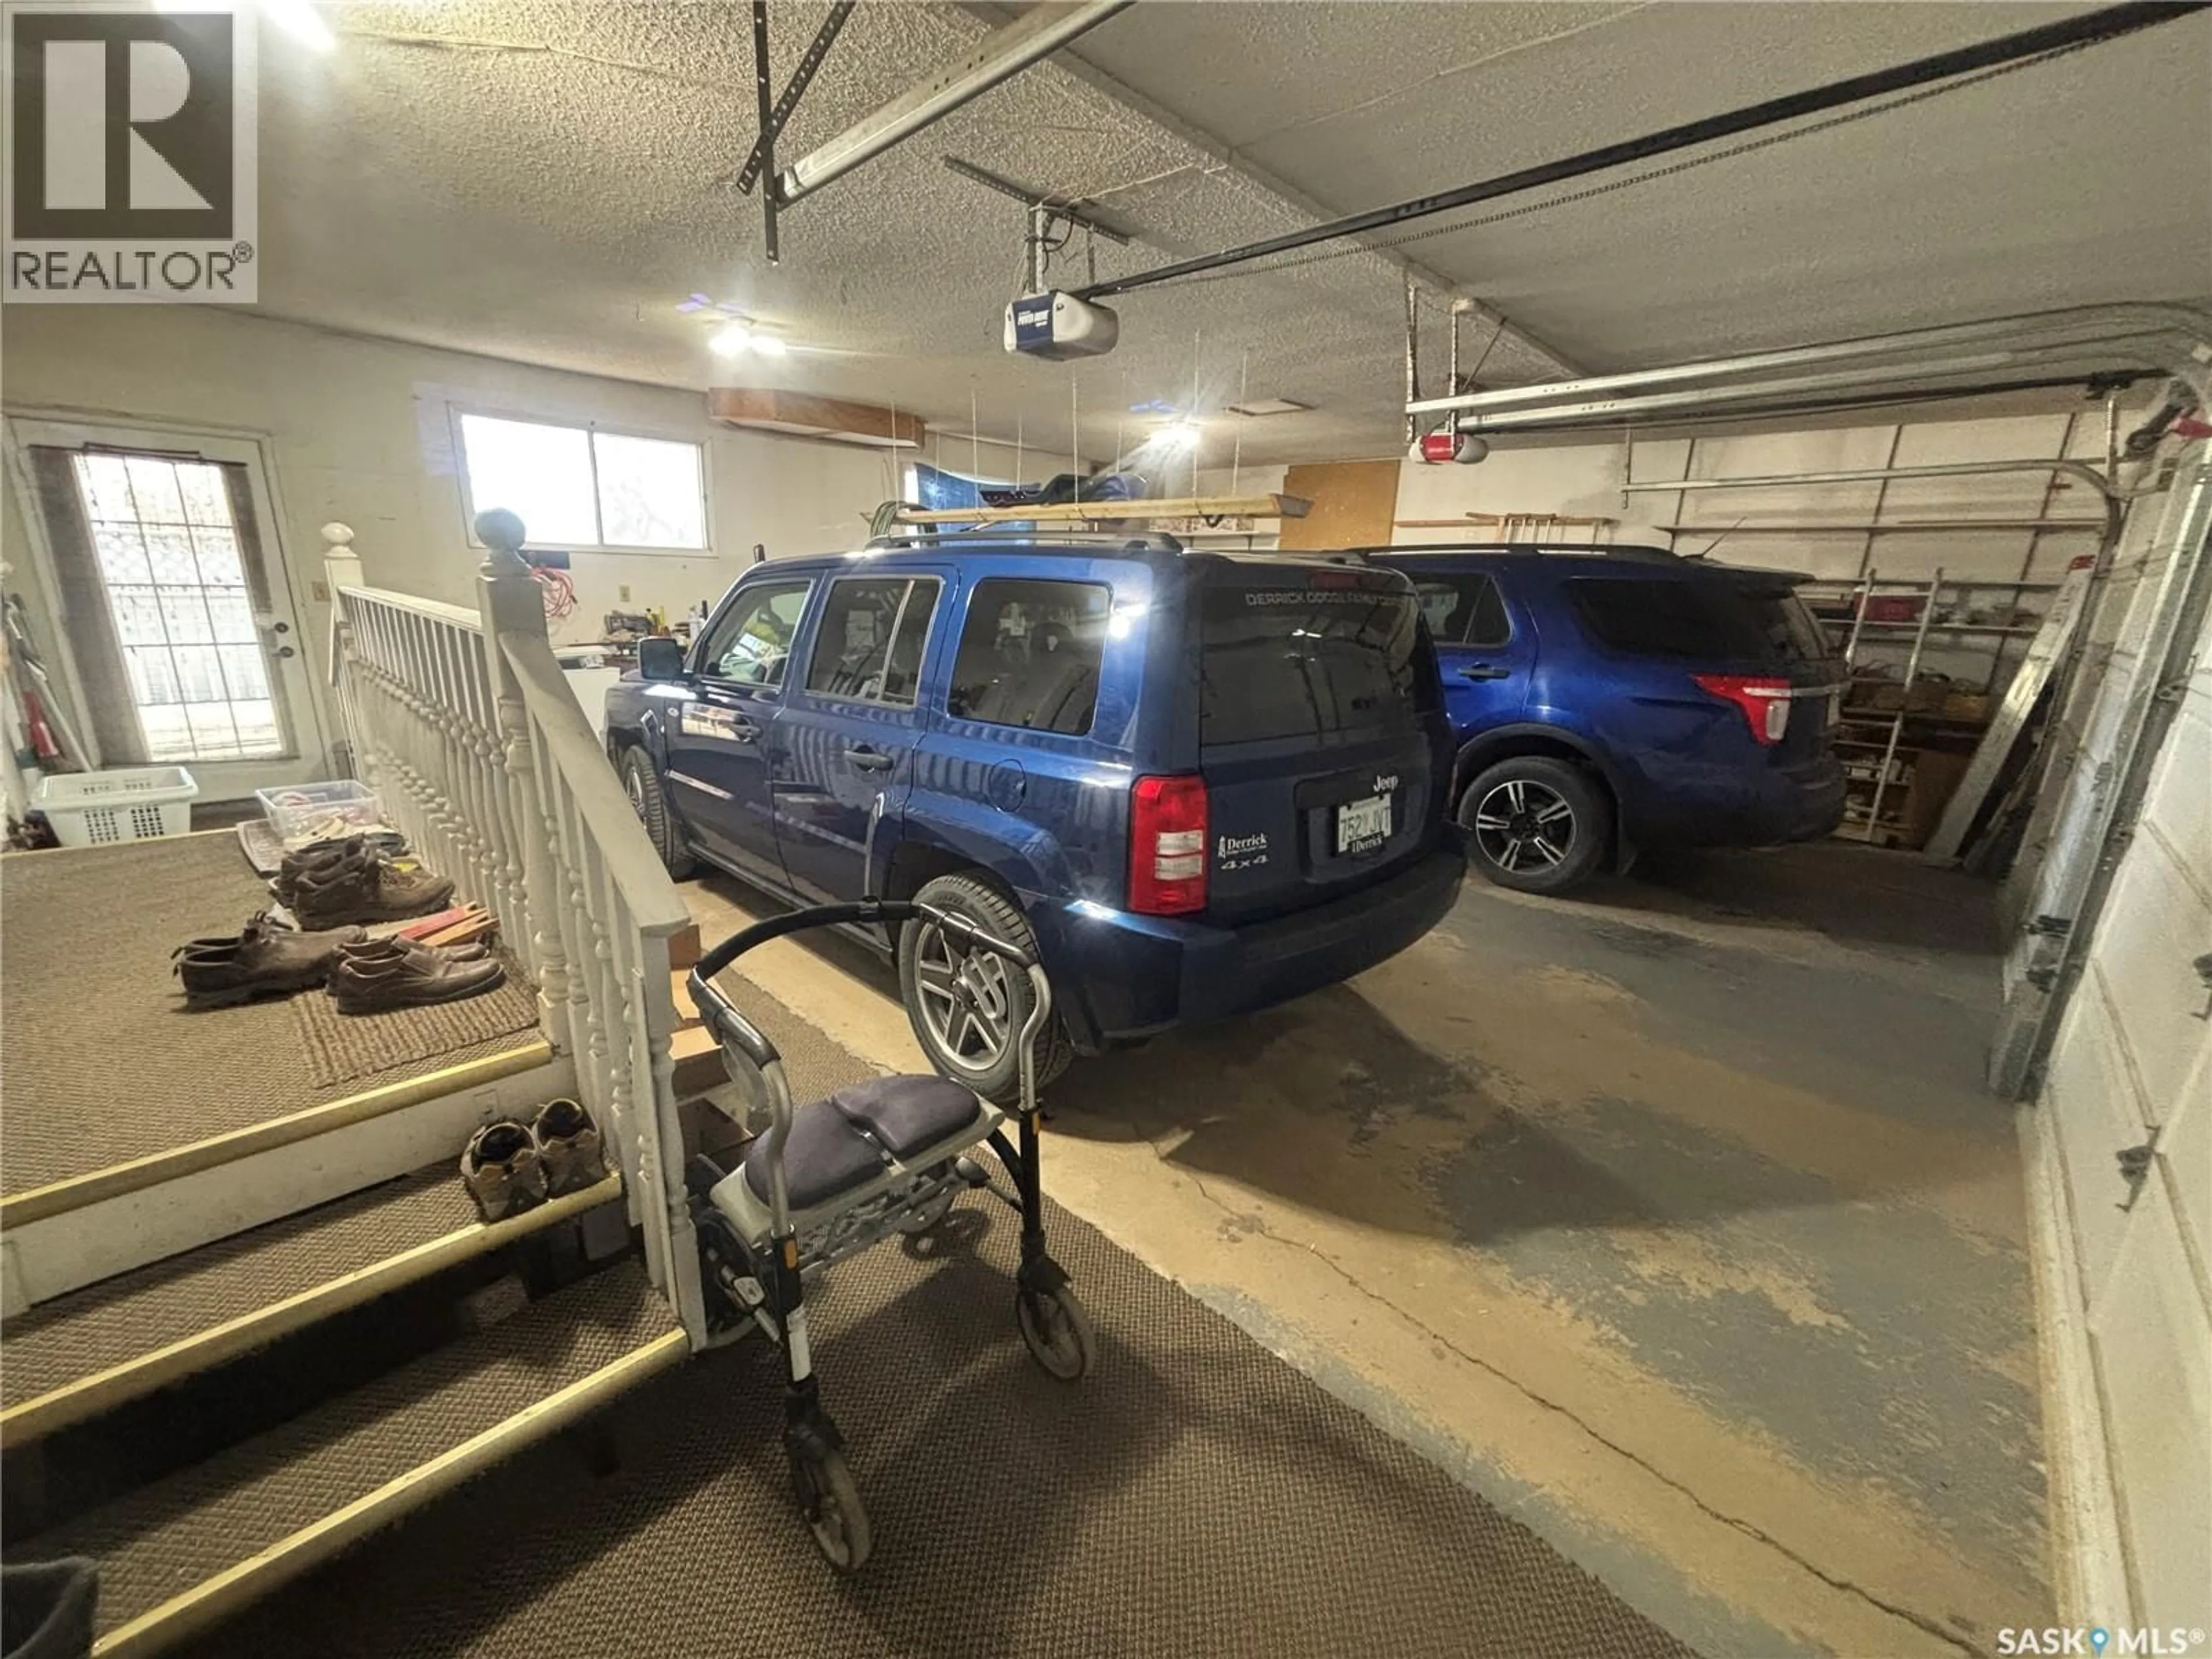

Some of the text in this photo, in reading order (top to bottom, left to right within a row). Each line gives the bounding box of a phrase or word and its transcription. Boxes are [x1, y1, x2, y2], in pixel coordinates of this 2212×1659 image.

[1245, 593, 1305, 606] DERRICK
[1373, 775, 1399, 791] Jeep
[1227, 833, 1267, 850] Derrick
[1221, 854, 1269, 869] 4x4
